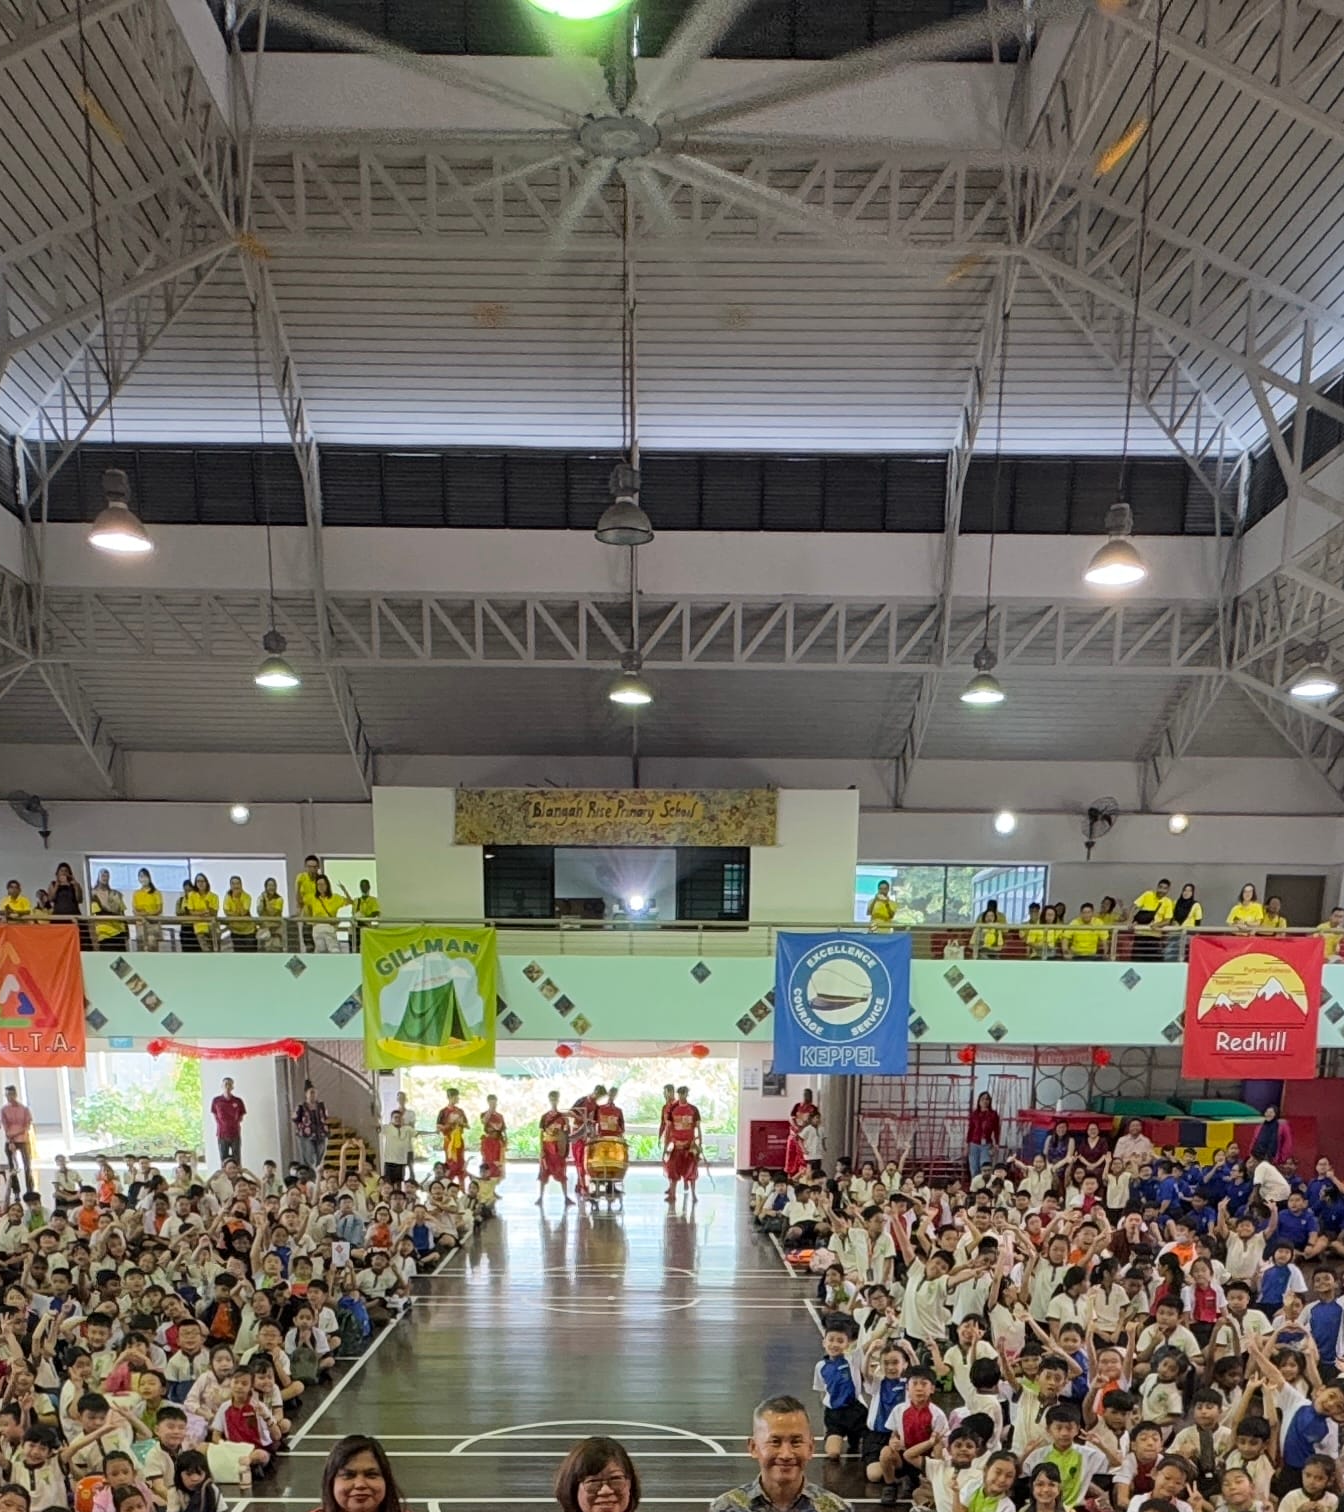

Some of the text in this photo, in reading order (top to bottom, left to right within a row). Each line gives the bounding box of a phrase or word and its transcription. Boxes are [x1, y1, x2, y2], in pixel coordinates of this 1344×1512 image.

[587, 800, 612, 819] Rise
[614, 799, 655, 826] Primary
[660, 800, 698, 819] School
[375, 938, 481, 976] GILLMAN
[806, 945, 878, 969] EXCELLENCE
[793, 987, 825, 1036] COURAGE
[850, 996, 886, 1037] SERVICE
[1216, 1031, 1287, 1052] Redhill
[799, 1045, 881, 1068] KEPPEL
